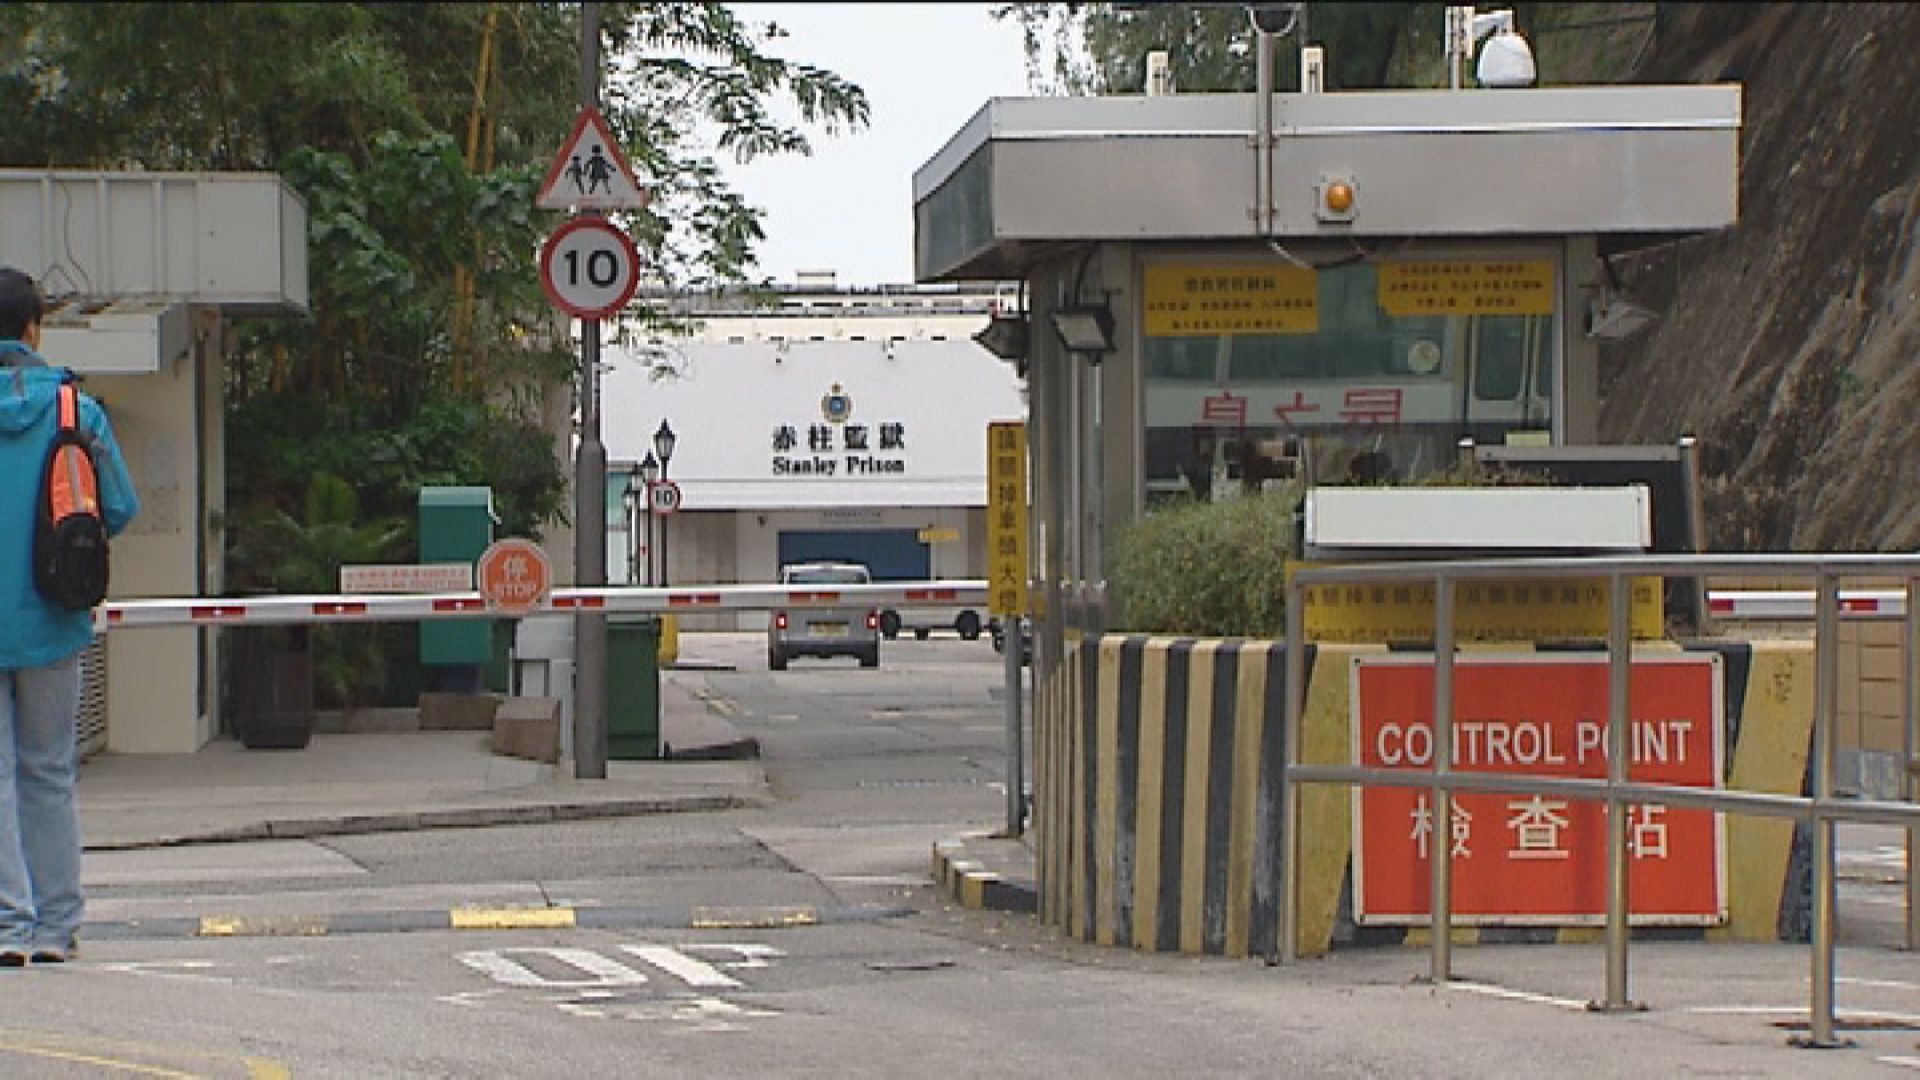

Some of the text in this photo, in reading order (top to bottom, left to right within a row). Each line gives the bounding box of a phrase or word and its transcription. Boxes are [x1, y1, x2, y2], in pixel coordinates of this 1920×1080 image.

[565, 250, 619, 288] 10
[773, 422, 905, 452] 赤柱監獄
[773, 455, 905, 476] Stanley Prison
[655, 489, 673, 506] 10
[493, 582, 537, 599] STOP
[1576, 720, 1693, 763] PINT
